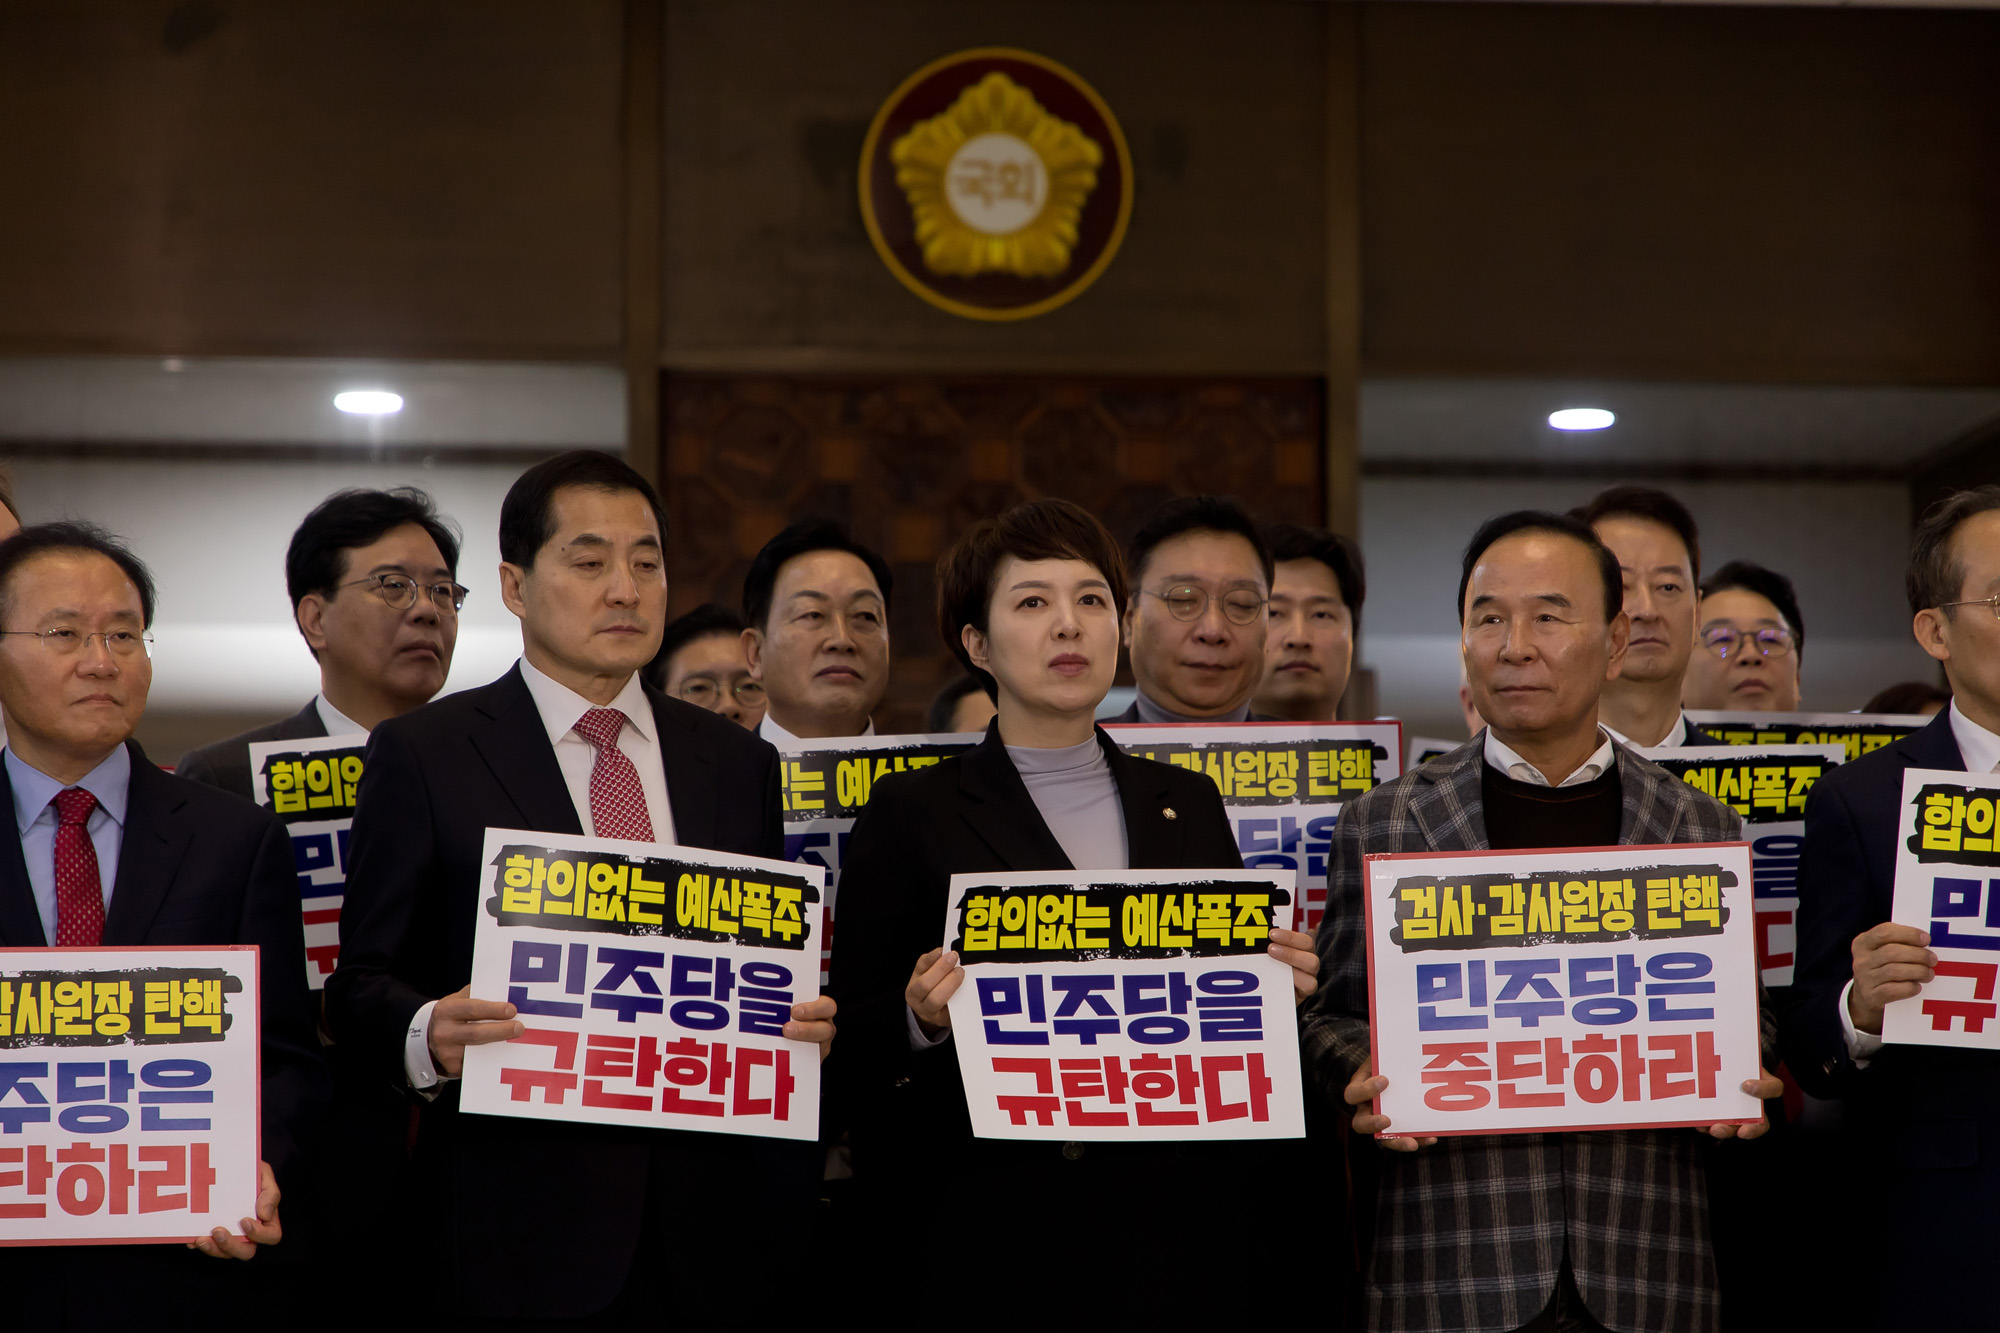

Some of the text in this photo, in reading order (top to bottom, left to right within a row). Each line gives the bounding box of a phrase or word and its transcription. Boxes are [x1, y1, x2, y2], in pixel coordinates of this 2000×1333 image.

[956, 157, 1036, 209] 국회
[1307, 748, 1372, 797] 탄핵
[500, 853, 666, 926] 합의없는
[675, 872, 802, 942] 예산폭주
[963, 894, 1111, 952] 합의없는
[1121, 893, 1270, 948] 예산폭주
[1400, 874, 1722, 940] 검사·감사원장 탄핵
[144, 977, 222, 1036] 탄핵
[507, 940, 794, 1038] 민주당을
[974, 969, 1264, 1046] 민주당을
[1416, 951, 1716, 1033] 민주당은
[1921, 957, 1999, 1034] 규
[500, 1027, 795, 1122] 규탄한다
[990, 1052, 1273, 1127] 규탄한다
[1421, 1030, 1722, 1112] 중단하라
